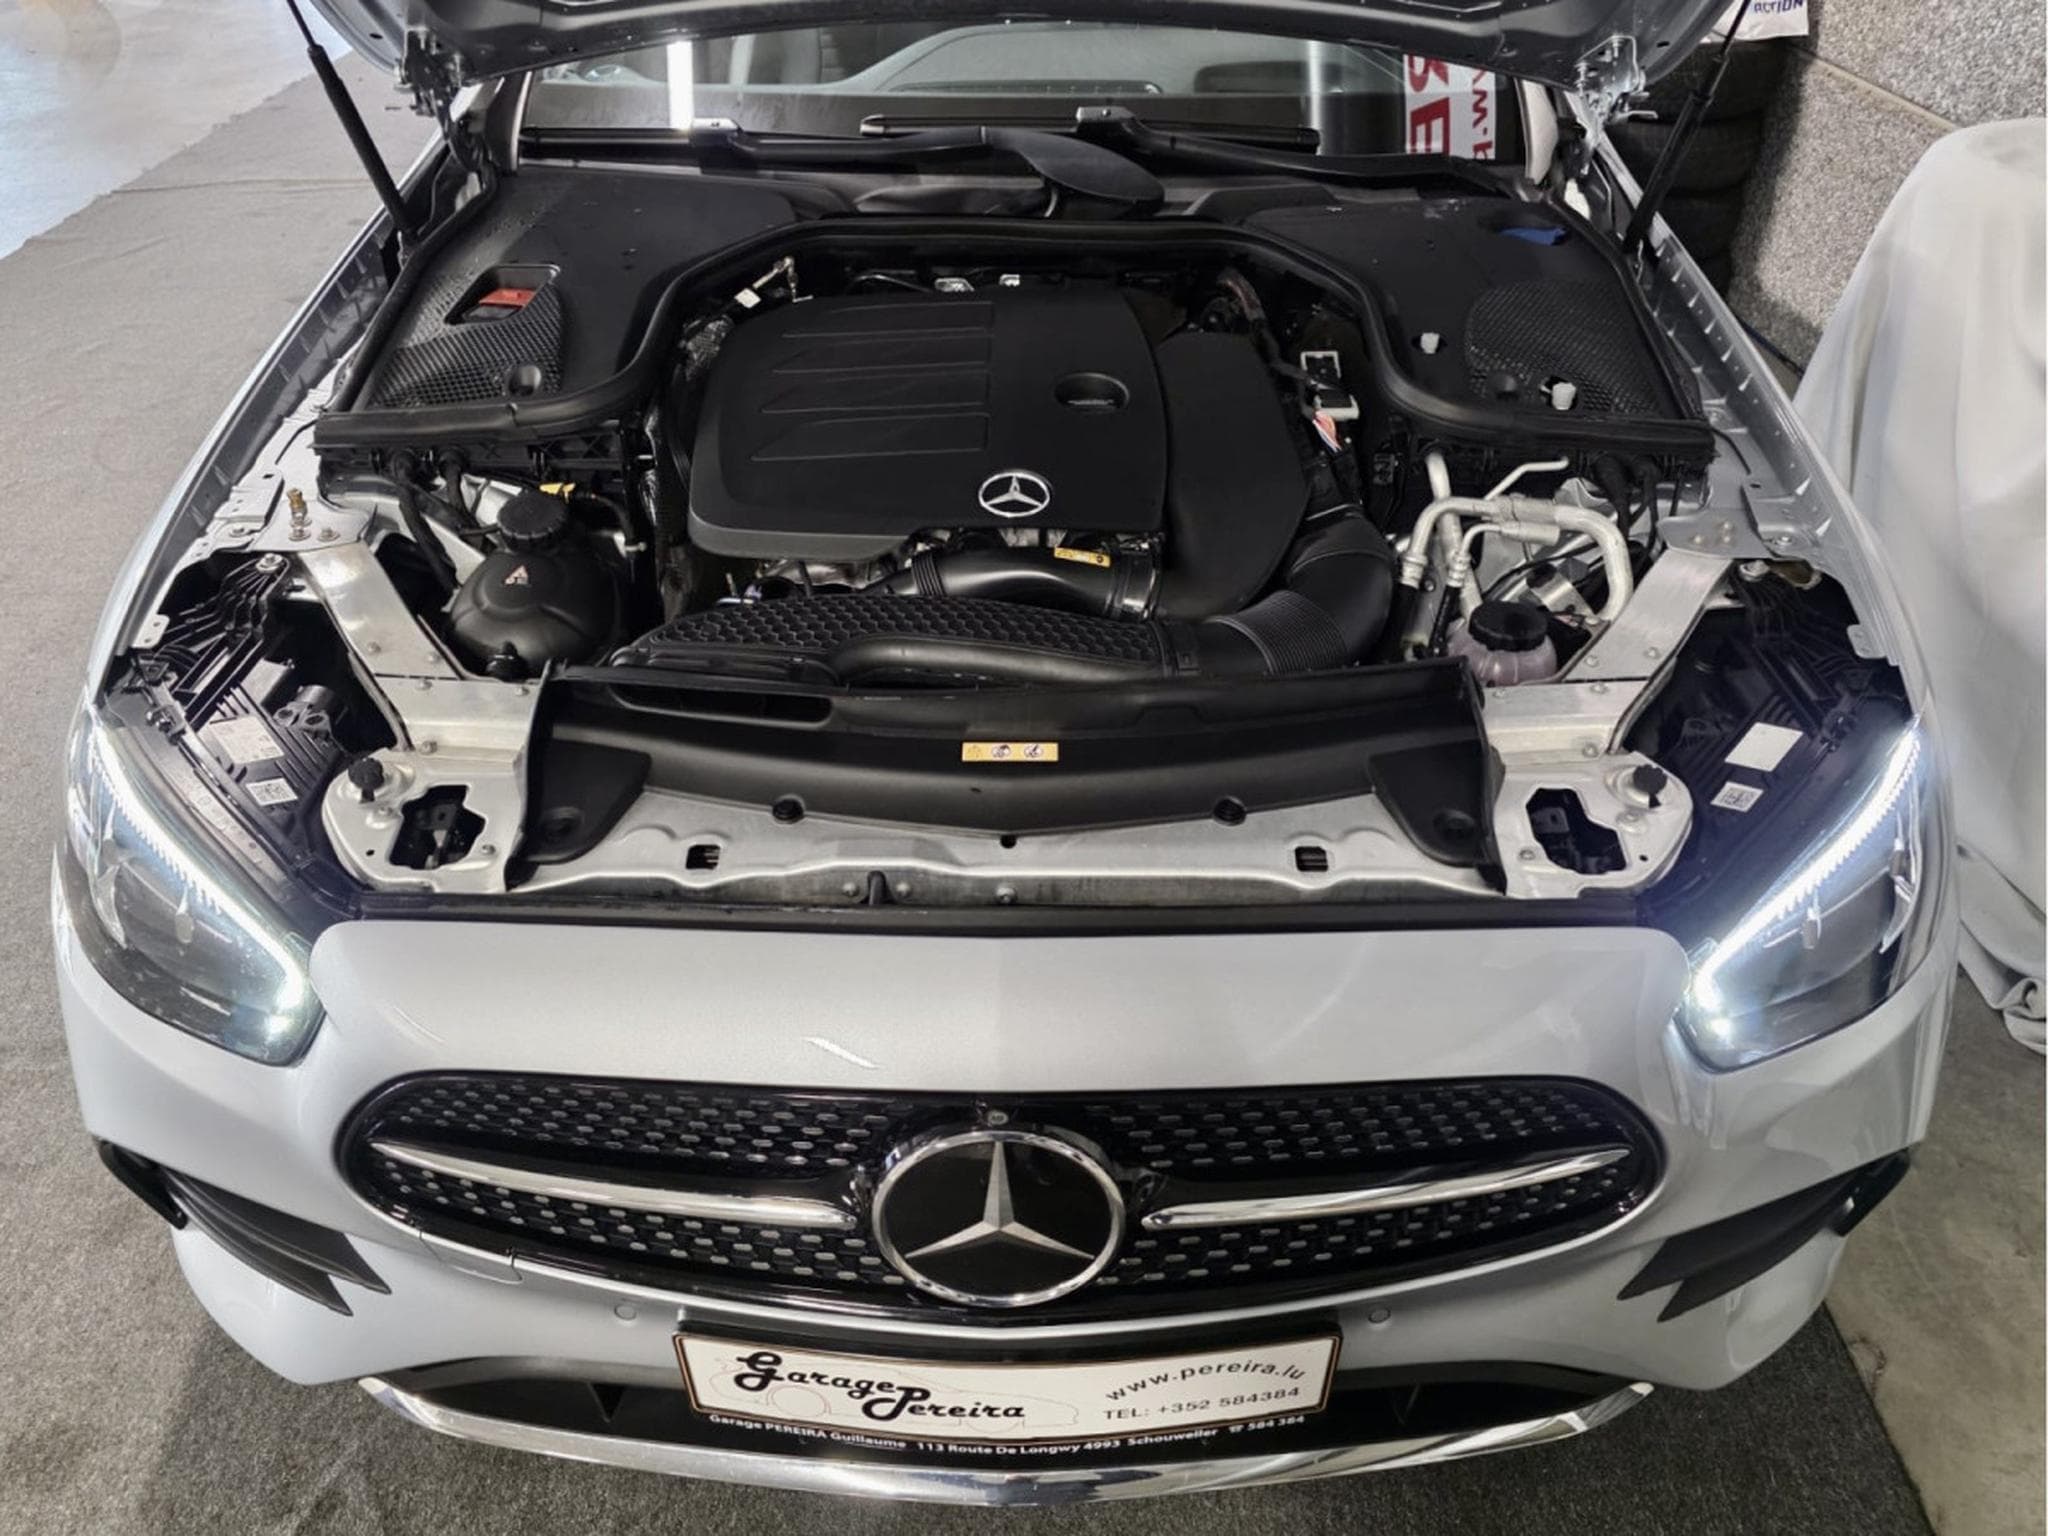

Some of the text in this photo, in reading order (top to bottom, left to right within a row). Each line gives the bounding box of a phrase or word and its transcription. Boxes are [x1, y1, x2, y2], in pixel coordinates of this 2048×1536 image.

[734, 1351, 897, 1400] Garage
[1106, 1360, 1306, 1400] www.pereira.lu
[862, 1386, 1025, 1421] Pereira
[1103, 1387, 1300, 1419] TEL: +352 584384
[709, 1414, 763, 1430] Garage
[765, 1422, 828, 1439] PEREIRA
[830, 1431, 907, 1449] Guillaume
[917, 1441, 945, 1451] 113
[948, 1444, 993, 1454] Route
[996, 1445, 1018, 1455] De
[1020, 1443, 1081, 1455] Longwy
[1083, 1439, 1121, 1450] 4993
[1247, 1419, 1275, 1431] 584
[1277, 1415, 1305, 1426] 384
